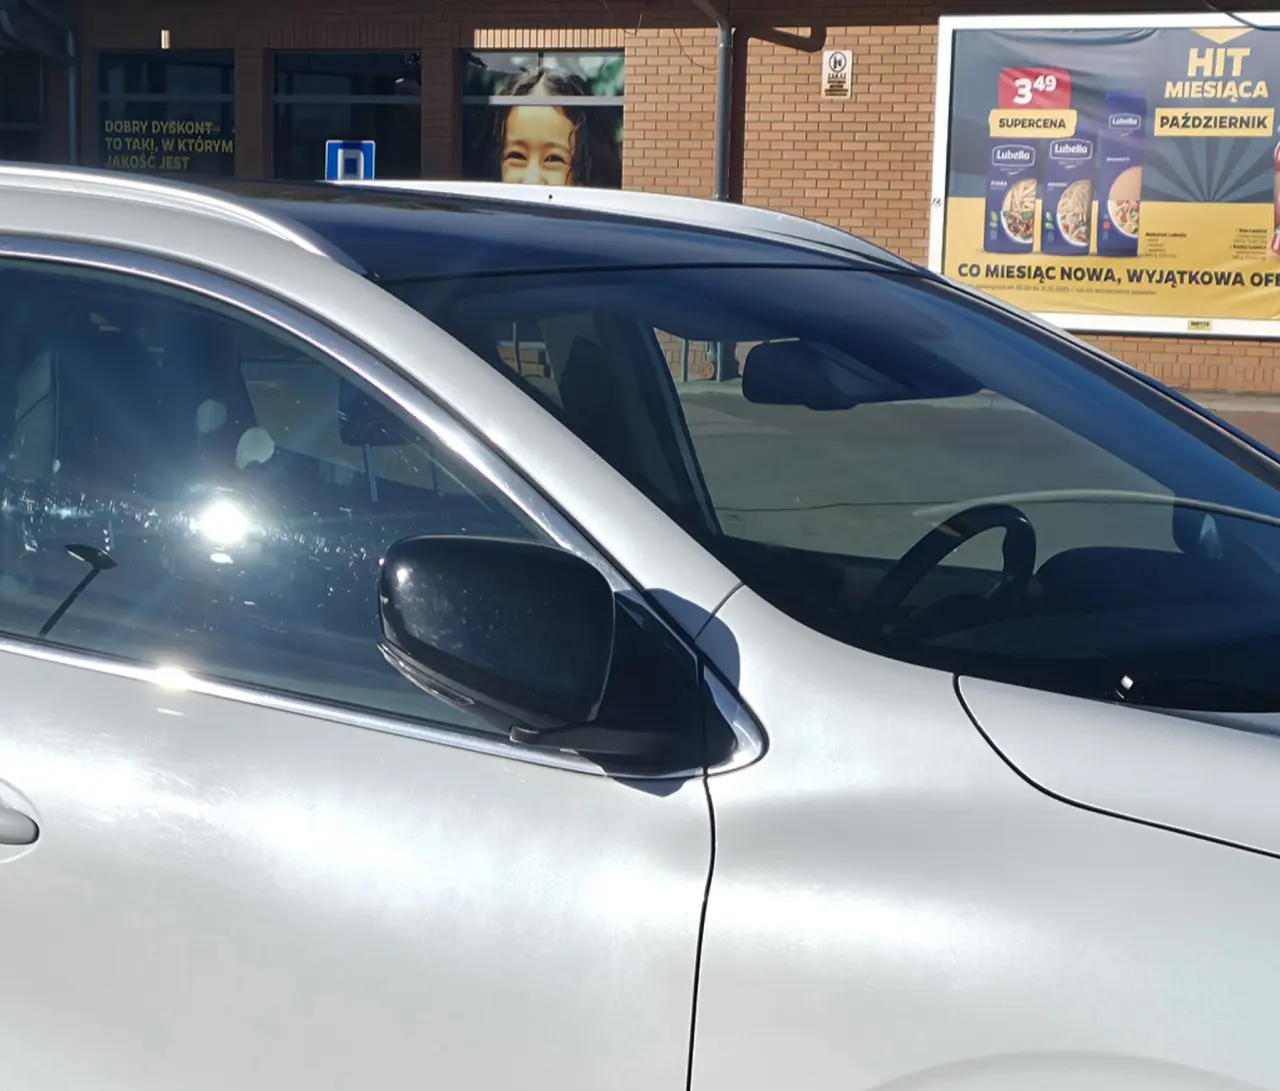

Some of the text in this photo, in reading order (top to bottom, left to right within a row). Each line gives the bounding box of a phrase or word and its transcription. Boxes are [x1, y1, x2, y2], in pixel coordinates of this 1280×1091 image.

[1187, 47, 1251, 77] HIT
[1164, 80, 1269, 103] MIESIĄCA
[104, 120, 213, 135] DOBRY DYSKONT
[998, 118, 1066, 129] SUPERCENA
[1160, 112, 1268, 129] PAŹDZIERNIK
[104, 138, 123, 150] TO
[161, 139, 175, 151] W
[178, 136, 234, 153] KTÓRYM
[1054, 143, 1088, 154] Lubella
[107, 152, 190, 169] JAKOŚĆ JEST
[996, 150, 1031, 160] Lubella
[958, 263, 981, 277] CO
[985, 264, 1056, 283] MIESIĄC
[1060, 266, 1122, 285] NOWA,
[1126, 268, 1245, 288] WYJĄTKOWA
